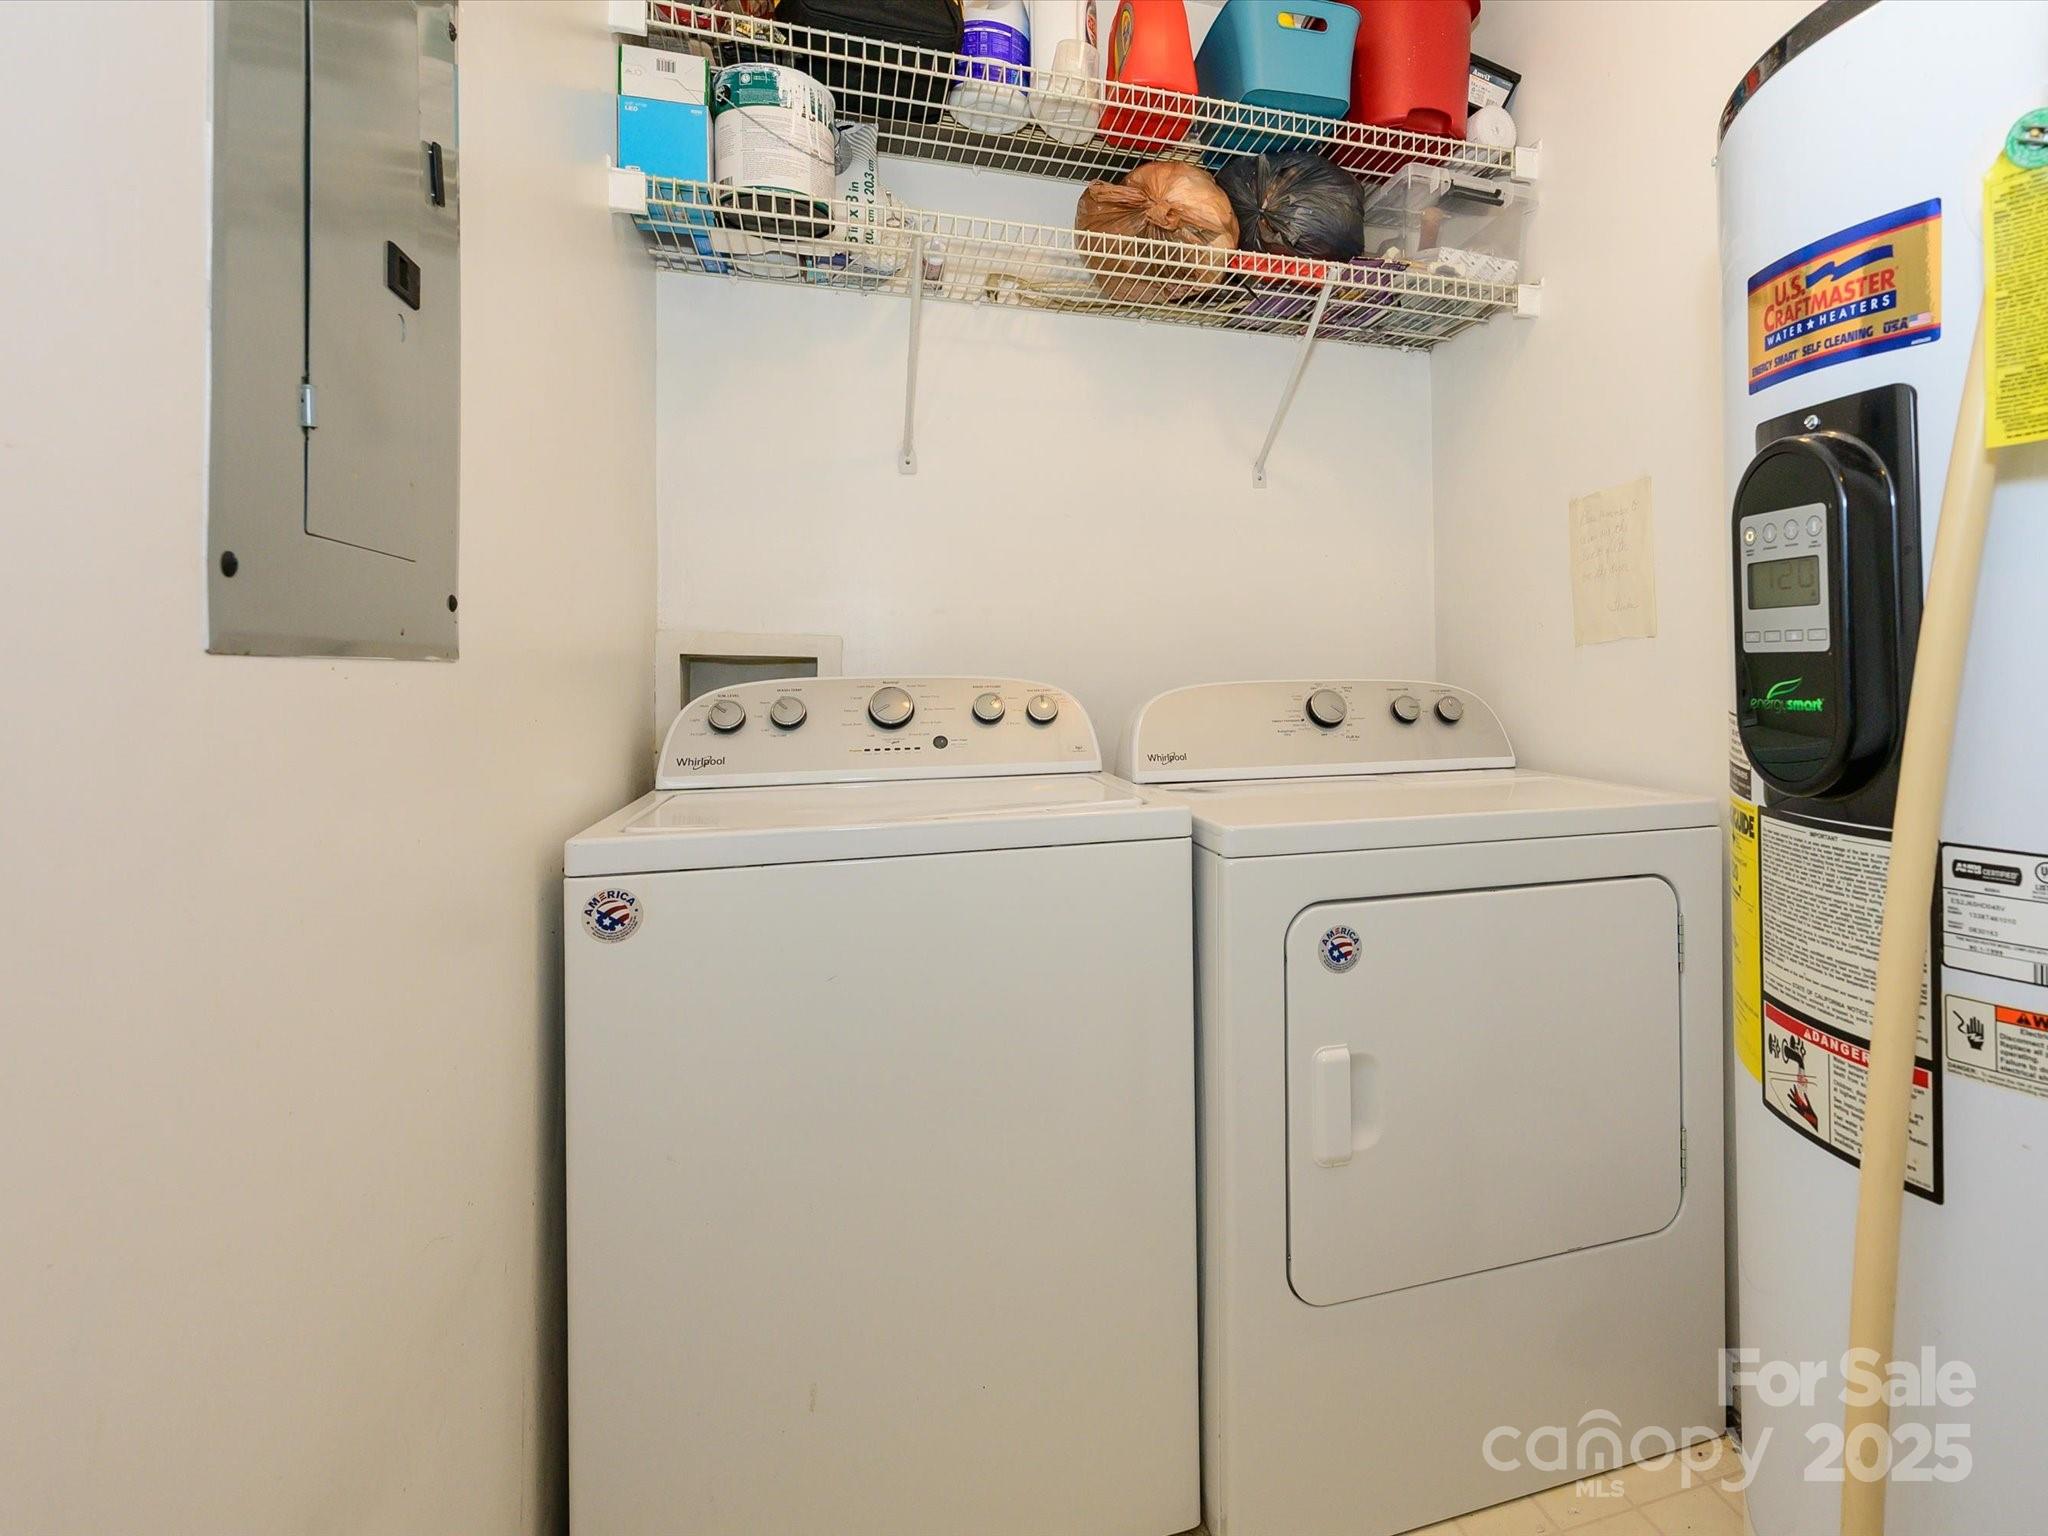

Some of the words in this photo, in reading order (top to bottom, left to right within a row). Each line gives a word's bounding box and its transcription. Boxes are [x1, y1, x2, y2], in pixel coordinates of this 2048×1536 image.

[1471, 68, 1491, 82] Anvil
[848, 181, 859, 192] in
[864, 171, 875, 196] 20.3
[1763, 268, 1896, 332] CRAFTMASTER
[1774, 273, 1807, 306] U.S.
[1766, 323, 1803, 346] WATER
[1819, 295, 1891, 326] HEATERS
[1774, 350, 1798, 369] SMART
[1802, 341, 1822, 357] SELF
[1824, 326, 1874, 349] CLEANING
[676, 756, 725, 770] Whirlpool
[1147, 752, 1187, 765] Whirlpool
[584, 890, 635, 917] AMERICA
[1322, 927, 1359, 946] AMERICA
